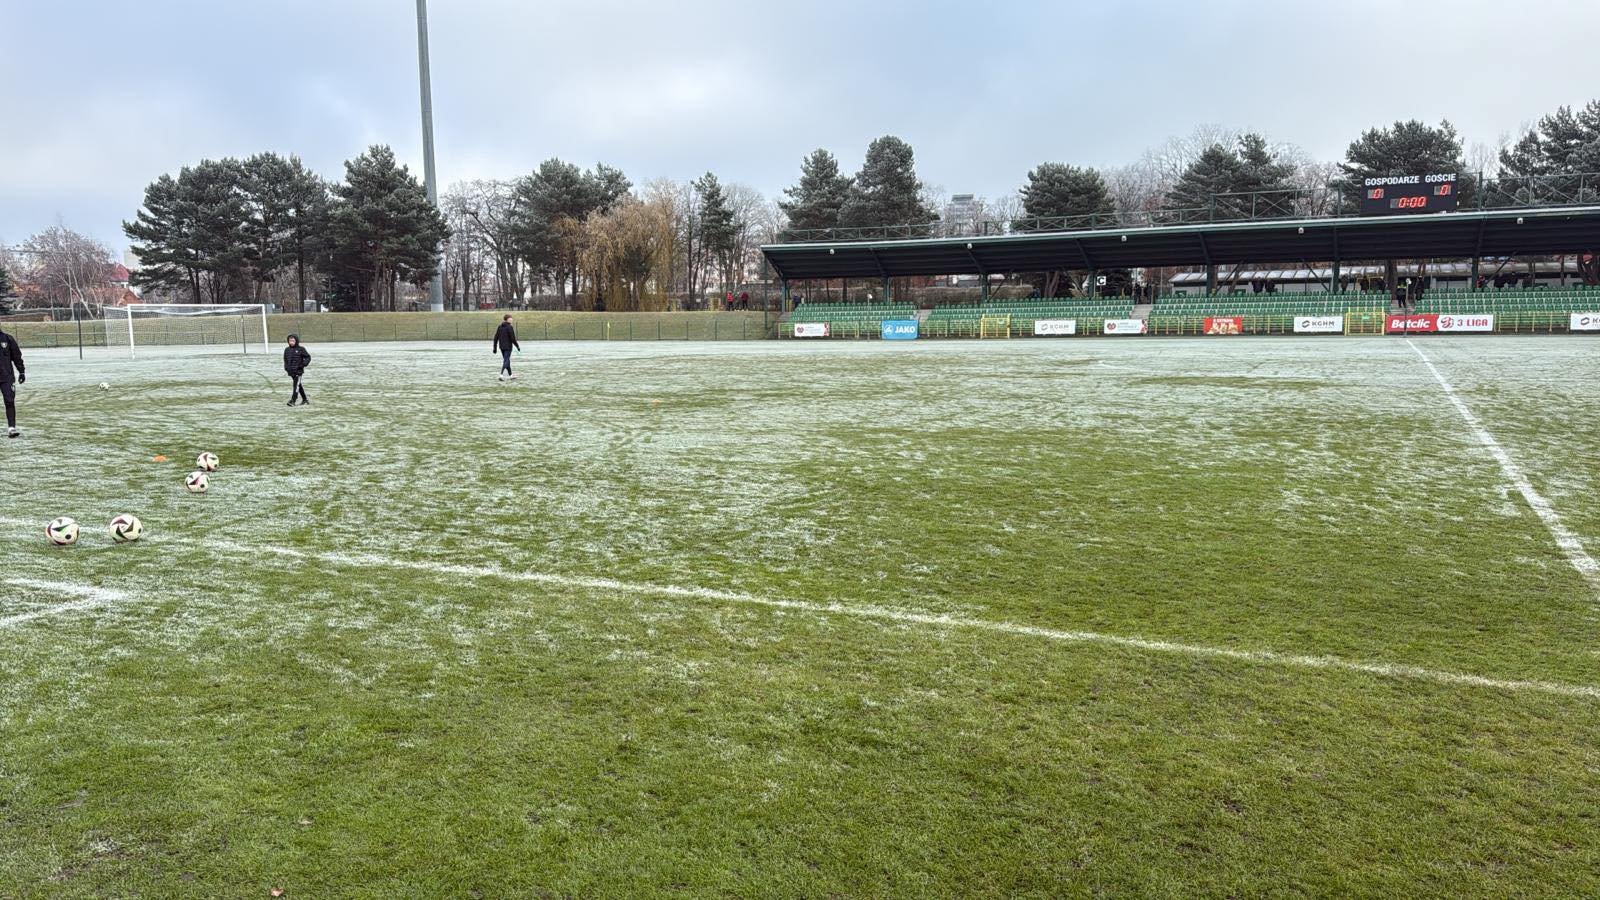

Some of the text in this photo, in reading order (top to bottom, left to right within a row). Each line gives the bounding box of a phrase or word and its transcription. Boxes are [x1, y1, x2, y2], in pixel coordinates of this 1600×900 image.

[1365, 176, 1419, 186] GOSPODARZE
[1440, 185, 1448, 195] 0
[1398, 197, 1426, 208] 0:00
[1097, 277, 1105, 285] C
[1391, 319, 1430, 328] Betclic
[1457, 319, 1488, 327] 3 LIGA
[894, 325, 916, 334] JAKO
